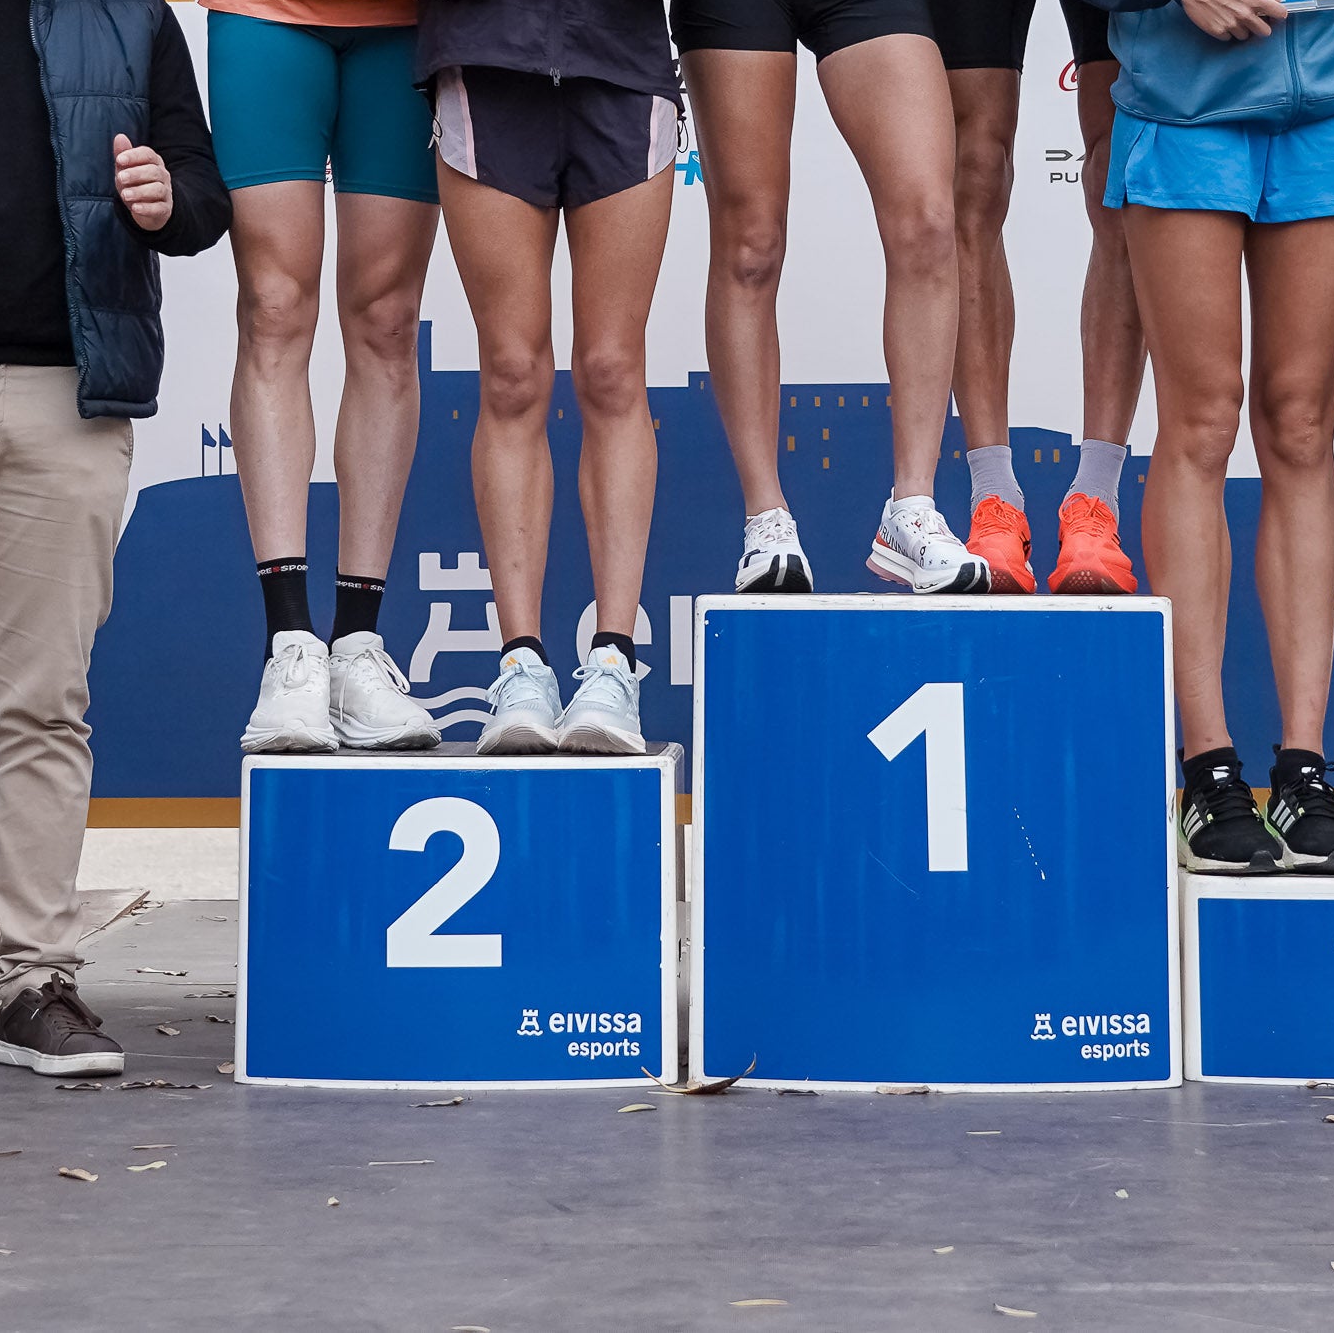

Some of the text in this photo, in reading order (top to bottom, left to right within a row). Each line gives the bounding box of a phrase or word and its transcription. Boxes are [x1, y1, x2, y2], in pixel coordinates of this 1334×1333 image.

[866, 682, 969, 872] 1
[386, 787, 503, 968] 2
[548, 1012, 642, 1034] eivissa
[1061, 1013, 1151, 1042] eivissa
[567, 1038, 641, 1060] esports
[1080, 1039, 1150, 1062] esports
